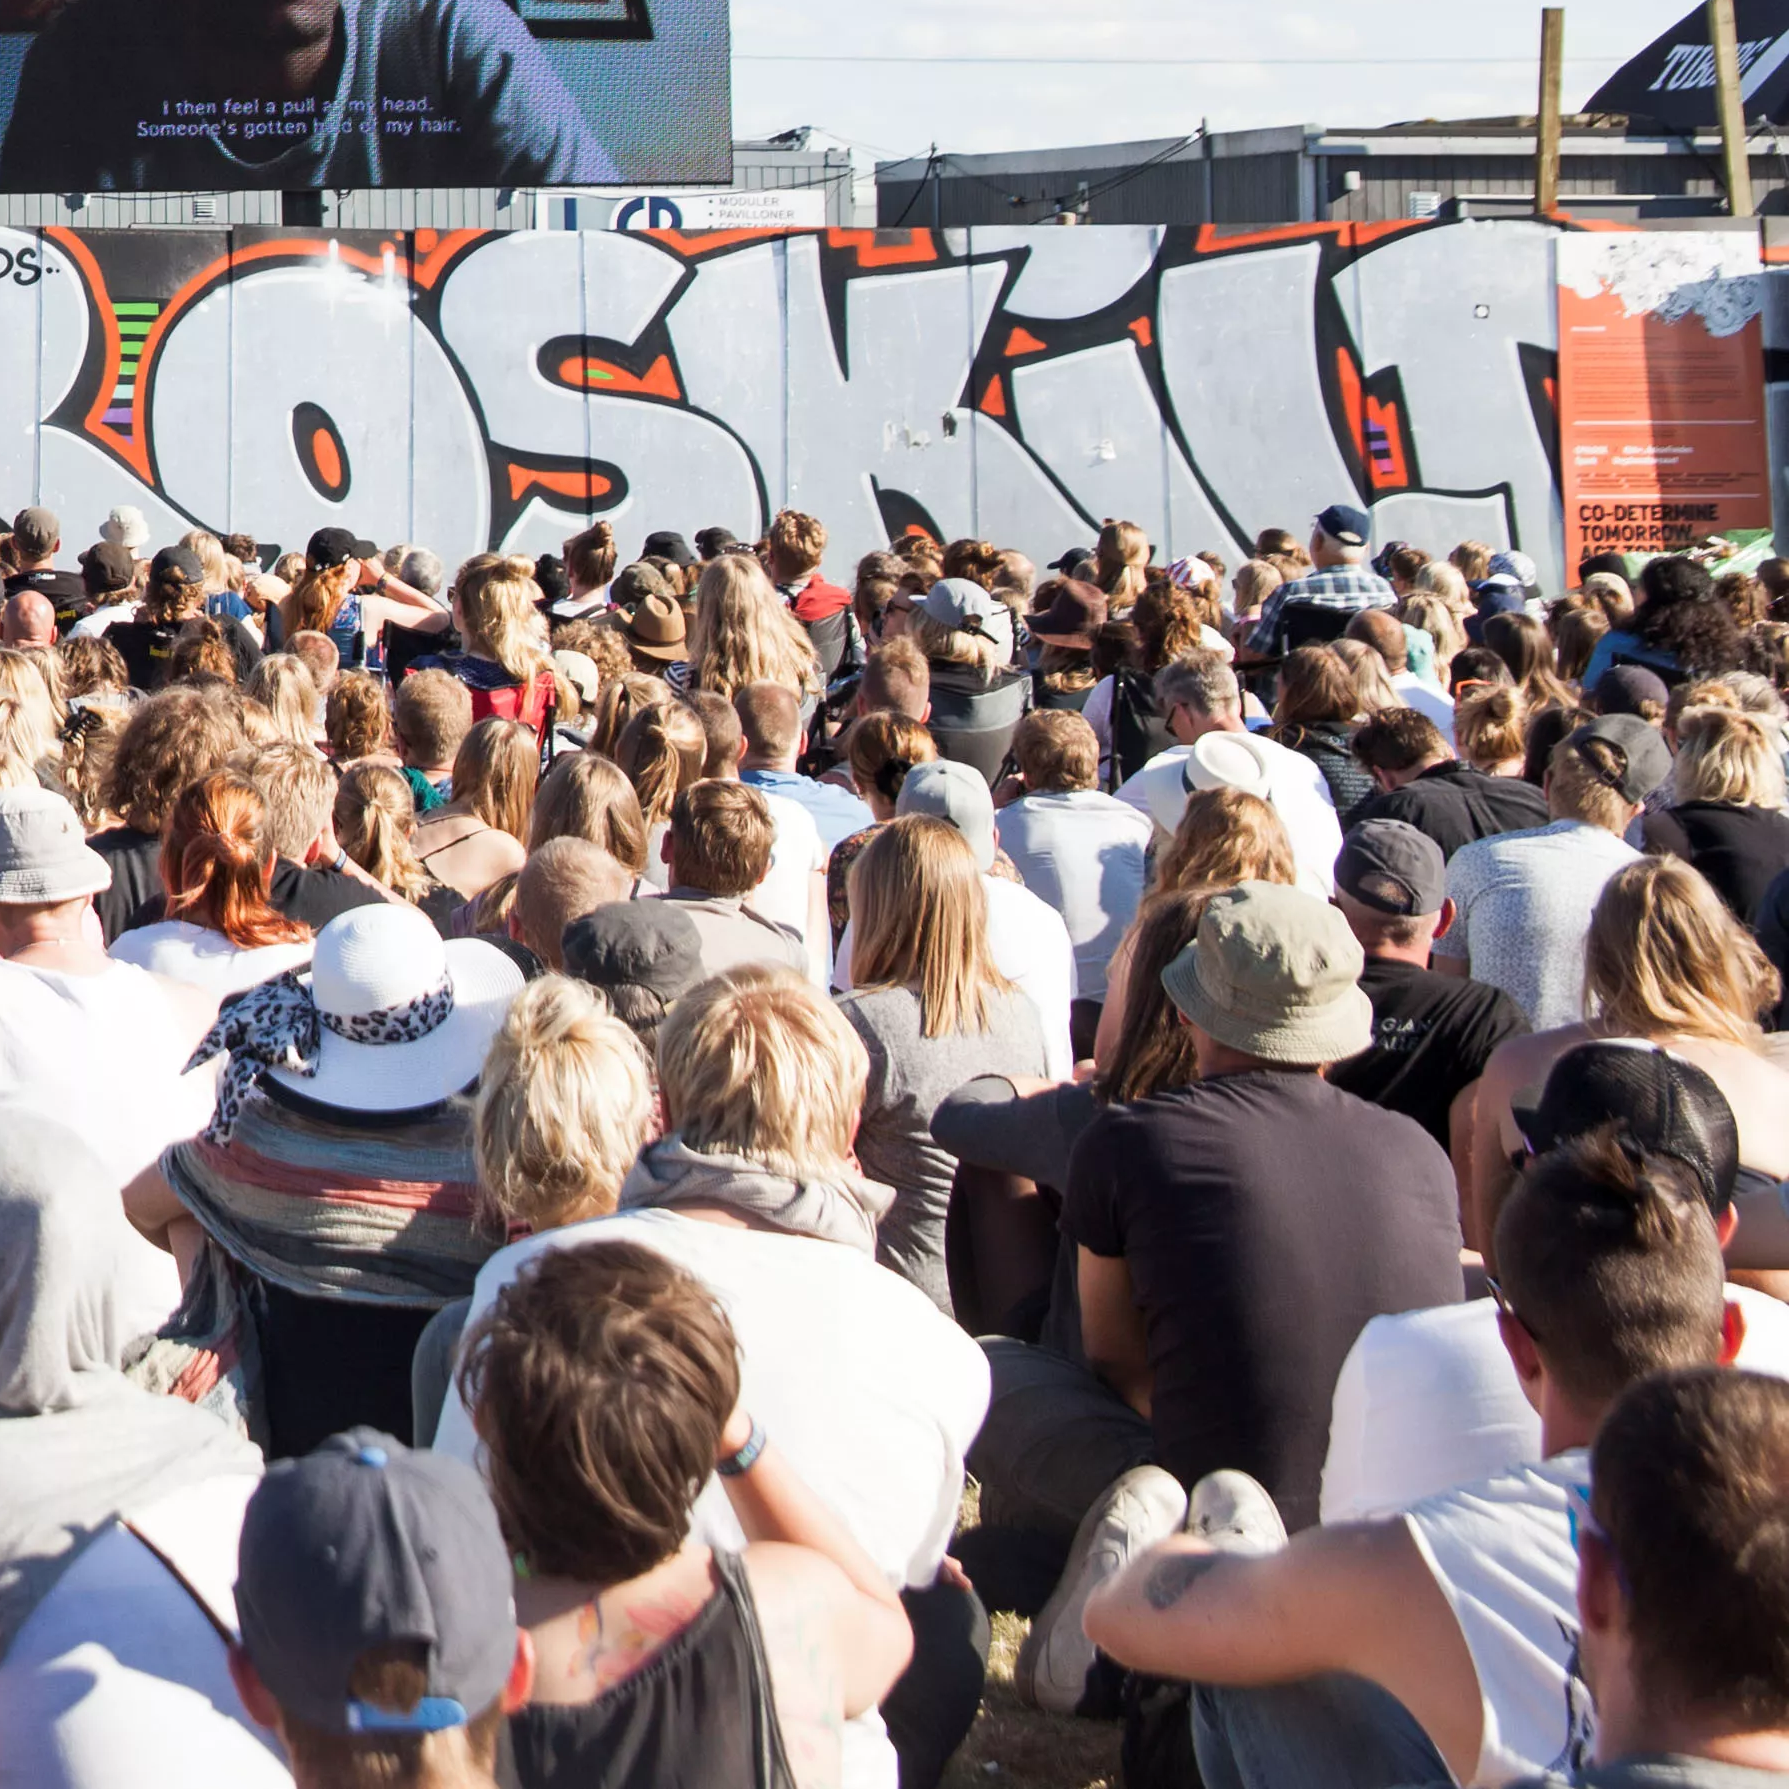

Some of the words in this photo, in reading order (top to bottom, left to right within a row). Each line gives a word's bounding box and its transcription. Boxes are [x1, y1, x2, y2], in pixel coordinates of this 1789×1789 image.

[175, 100, 216, 115] then
[224, 99, 259, 114] feel
[265, 101, 276, 113] a
[283, 97, 316, 117] pull
[381, 95, 435, 113] head.
[136, 119, 238, 138] Someone's
[243, 120, 308, 139] gotten
[385, 118, 413, 137] my
[420, 116, 462, 134] hair.
[718, 197, 780, 207] MODULER
[718, 209, 795, 220] PAVILLONER
[1578, 503, 1720, 522] CO-DETERMINE
[1579, 524, 1697, 542] TOMORROW.
